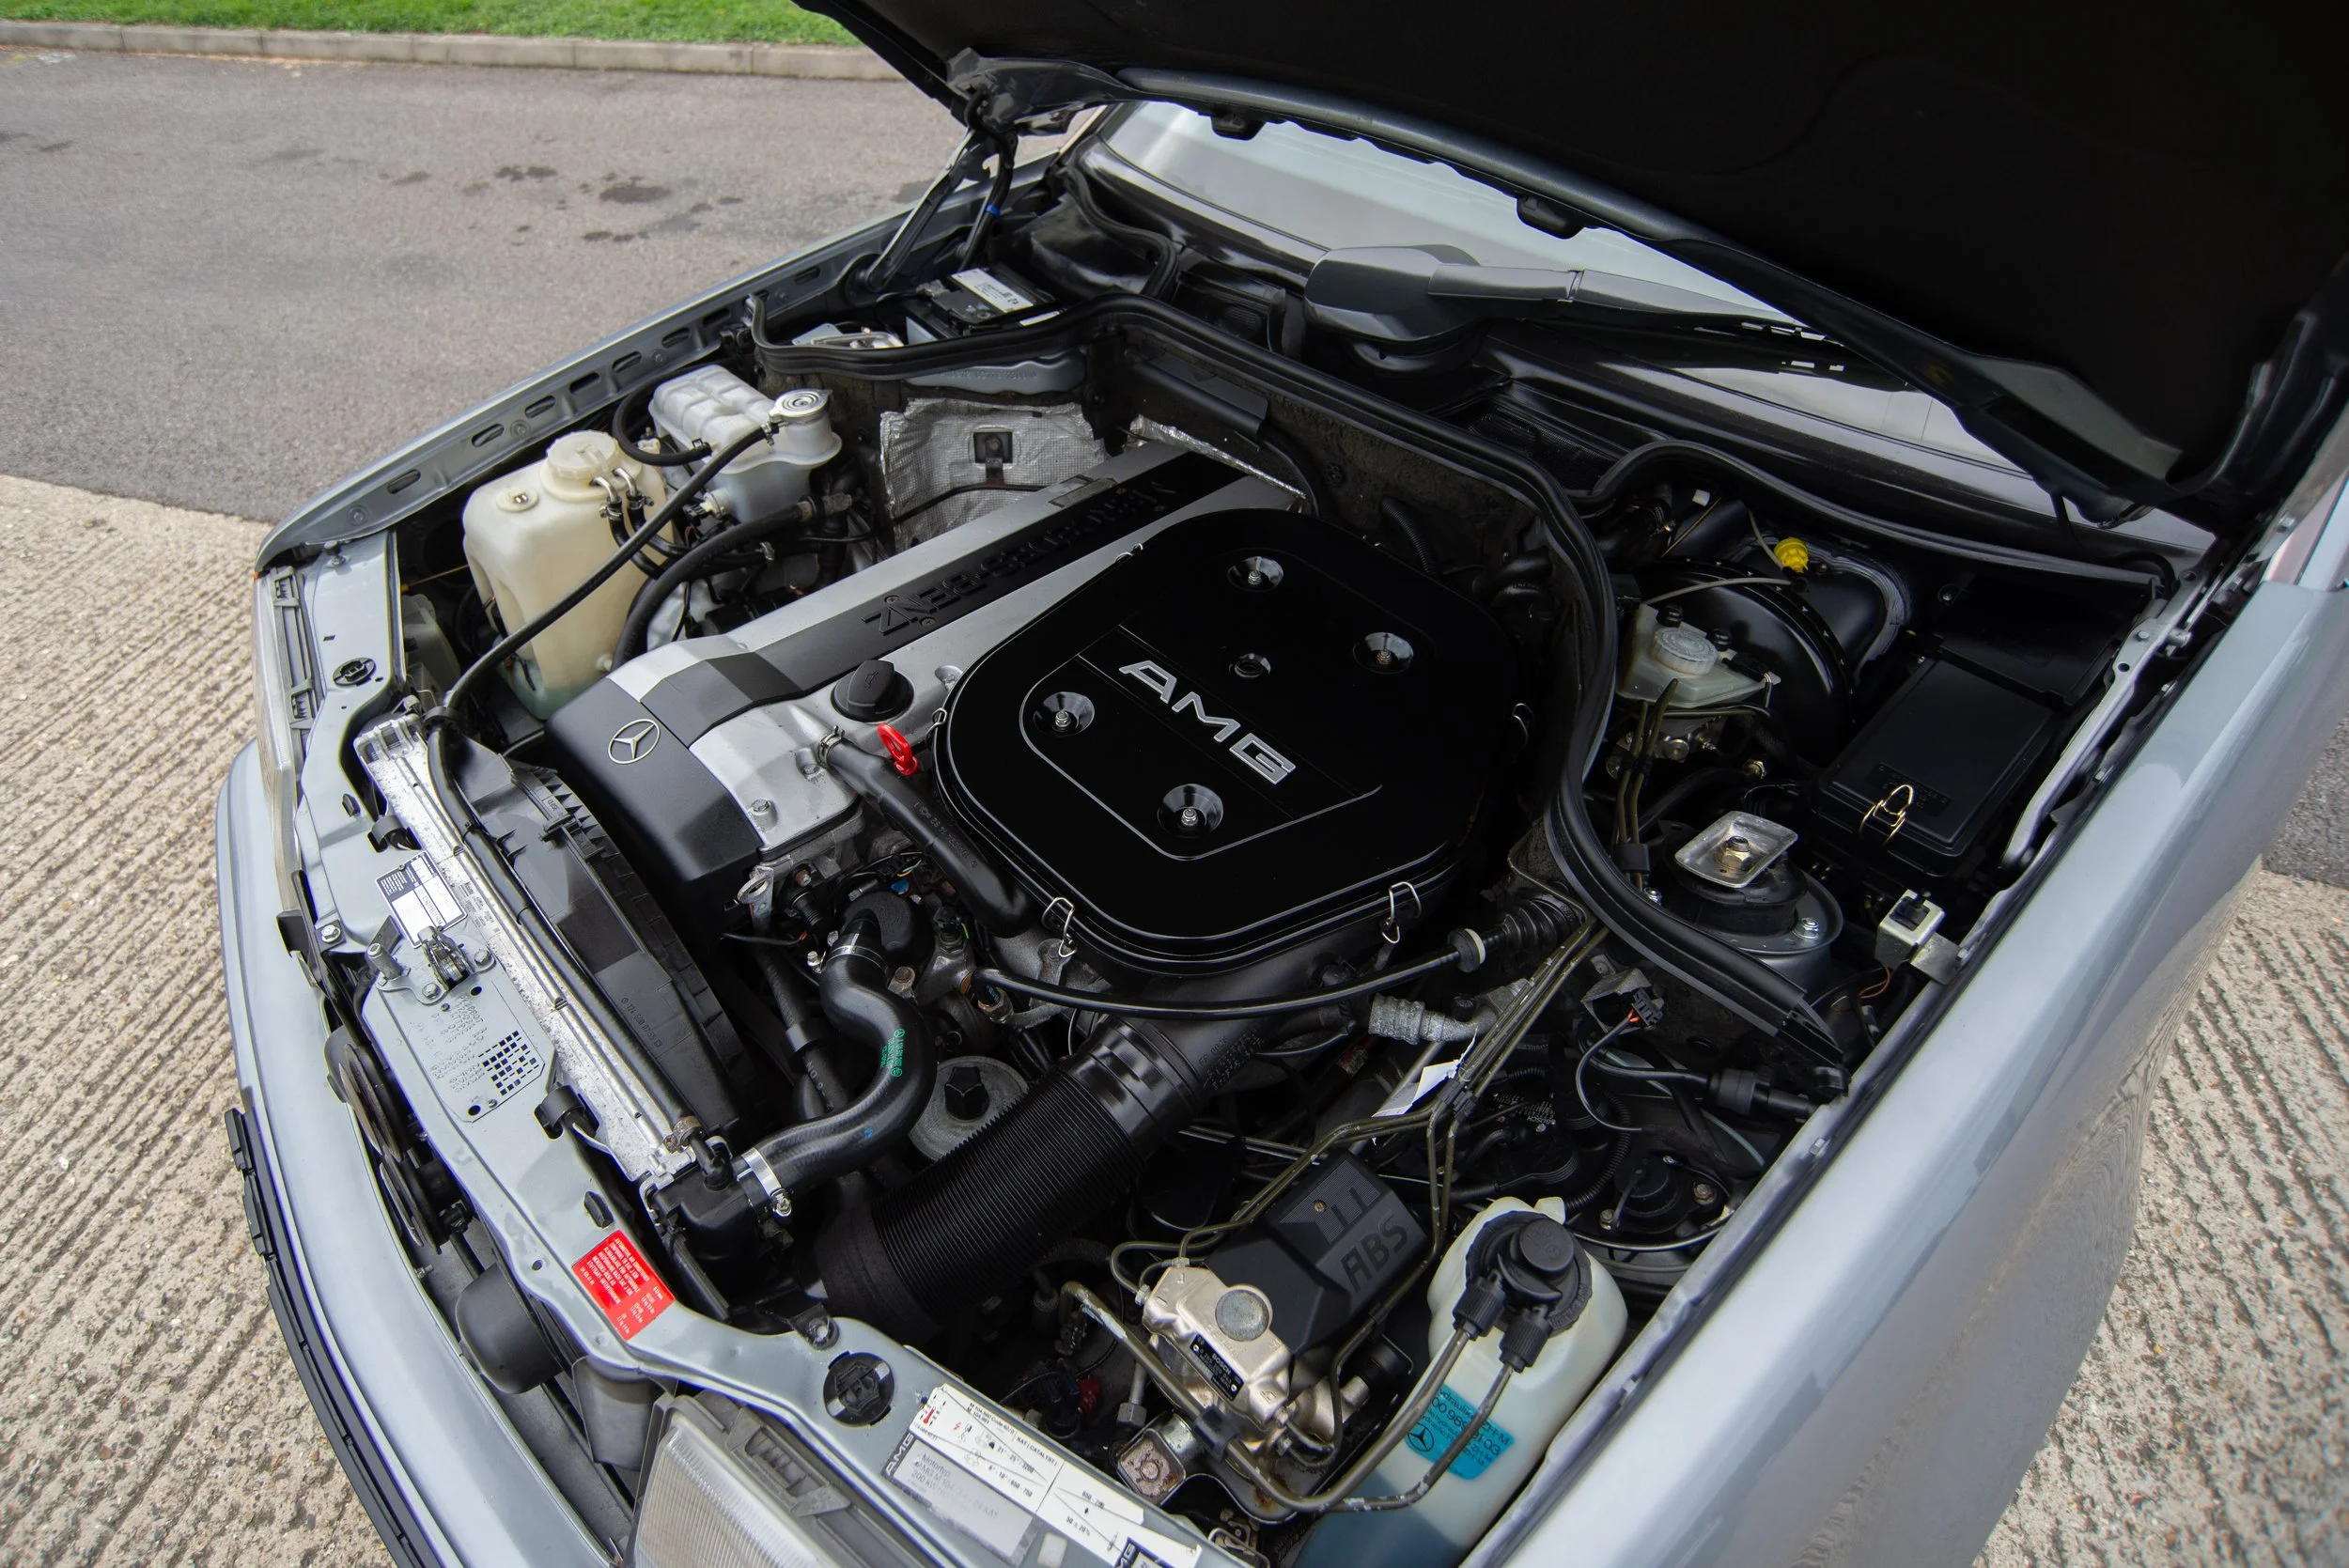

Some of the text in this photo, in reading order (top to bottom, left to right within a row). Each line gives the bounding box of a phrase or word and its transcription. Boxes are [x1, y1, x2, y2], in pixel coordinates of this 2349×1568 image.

[1118, 659, 1298, 786] AMG
[1338, 1209, 1410, 1294] ABS
[1210, 1352, 1232, 1374] BOSCH
[1016, 1436, 1027, 1445] KAT
[1482, 1437, 1501, 1455] 03
[884, 1433, 915, 1476] AMG
[920, 1452, 953, 1478] Motortyp
[910, 1468, 926, 1483] 200
